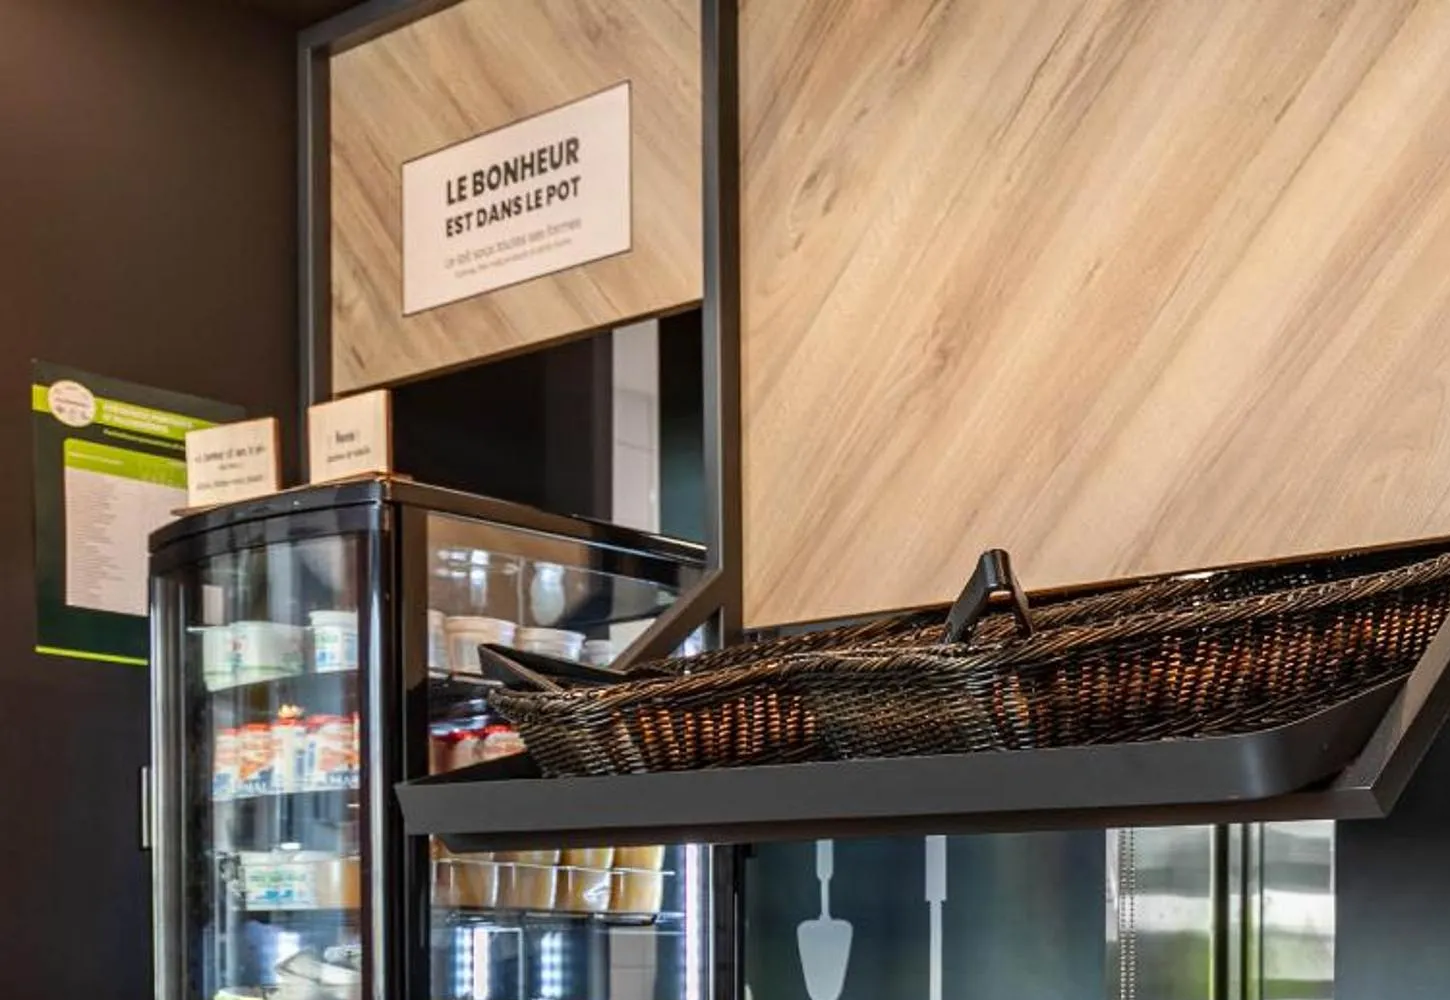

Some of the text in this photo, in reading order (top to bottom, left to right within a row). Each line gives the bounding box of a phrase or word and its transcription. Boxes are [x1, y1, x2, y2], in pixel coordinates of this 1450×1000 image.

[446, 137, 580, 206] LE BONHEUR
[446, 175, 581, 238] EST DANS LE POT
